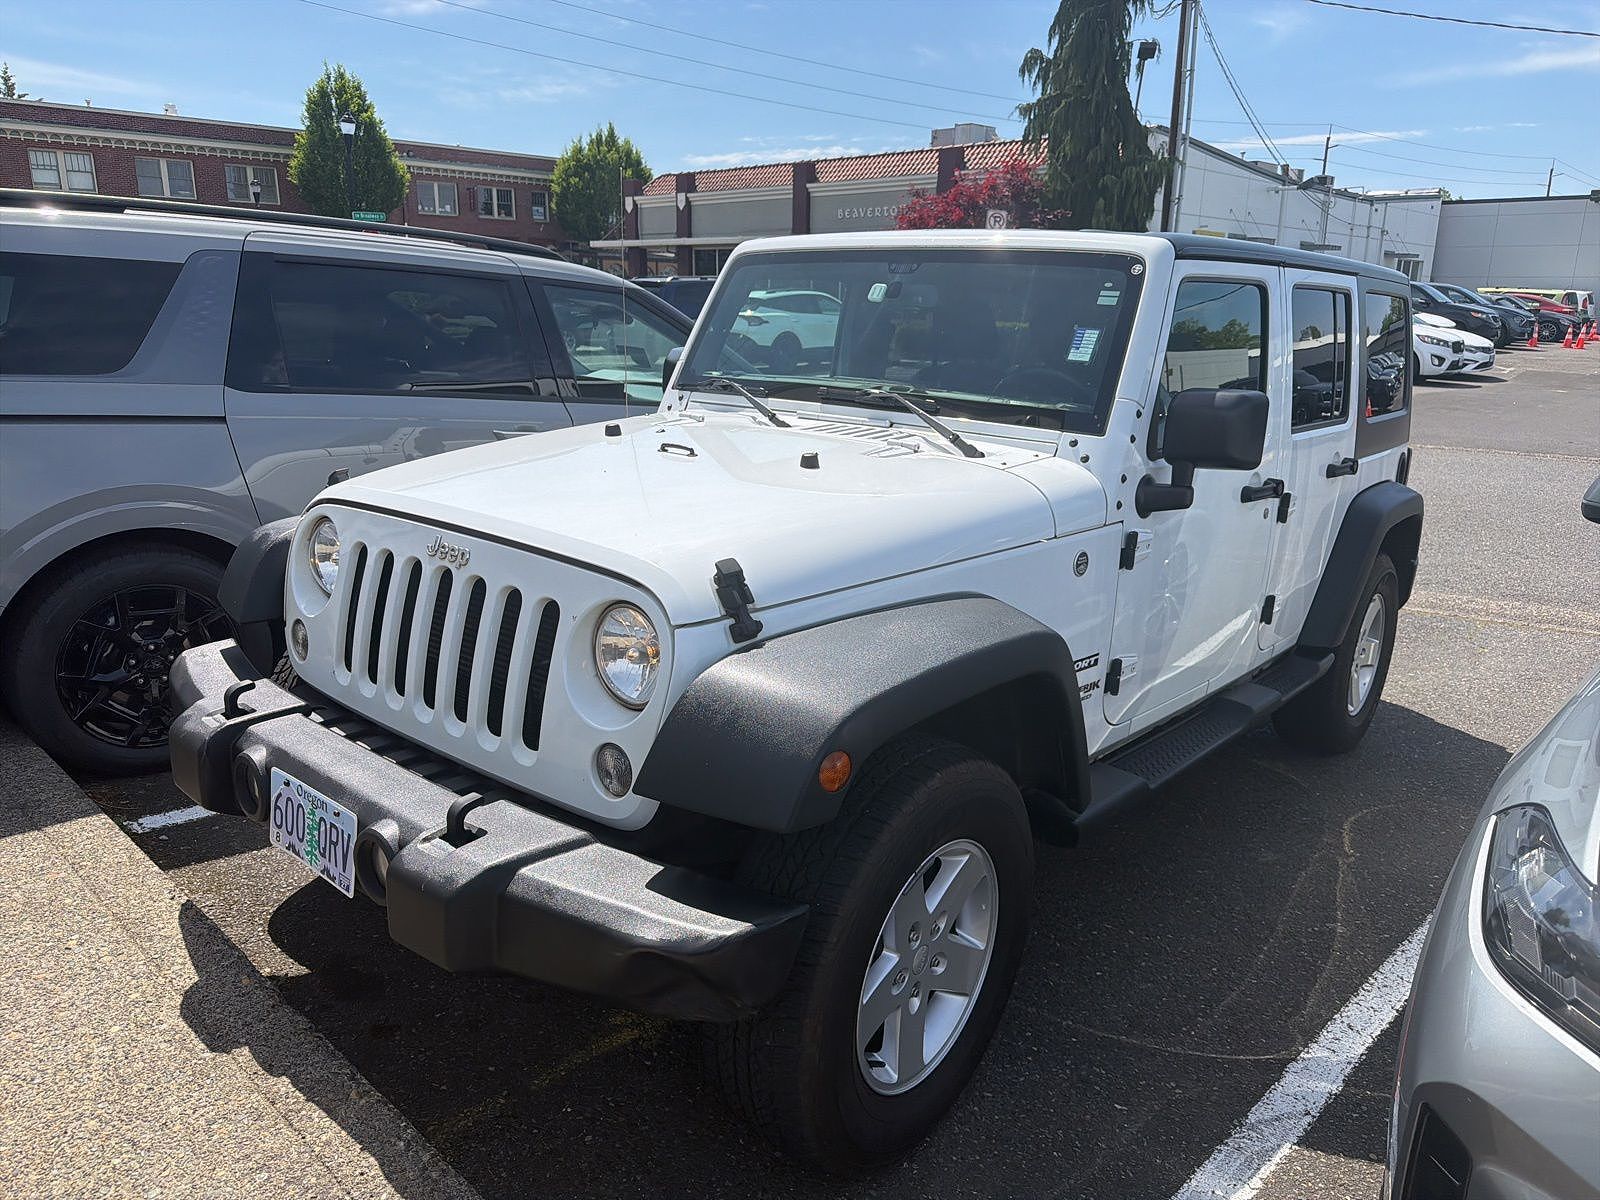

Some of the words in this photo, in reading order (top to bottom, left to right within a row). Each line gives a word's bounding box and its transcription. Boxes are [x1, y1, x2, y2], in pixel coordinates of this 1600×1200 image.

[837, 205, 906, 219] BEAVERTO
[427, 534, 471, 569] Jeep
[1074, 656, 1099, 671] ORT
[296, 784, 329, 814] Oregon
[273, 792, 306, 844] 600
[318, 816, 352, 874] QRV
